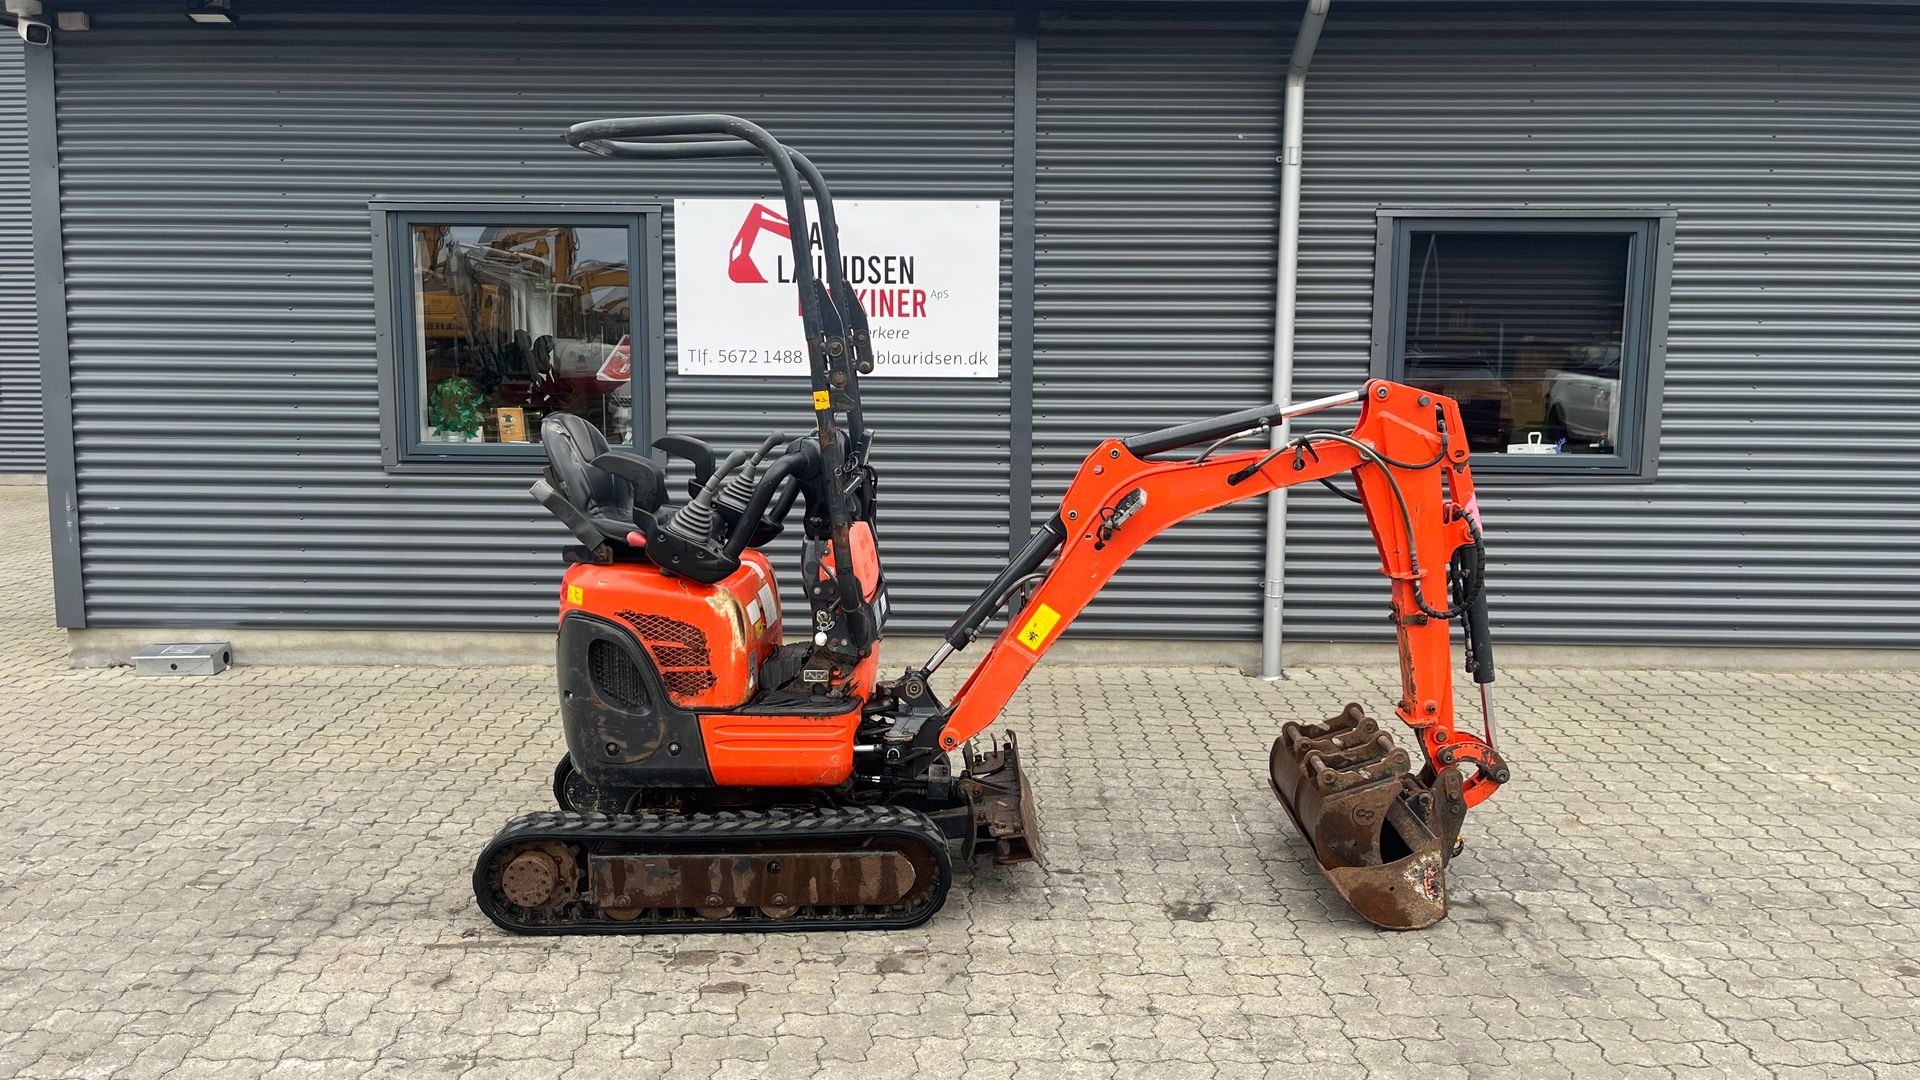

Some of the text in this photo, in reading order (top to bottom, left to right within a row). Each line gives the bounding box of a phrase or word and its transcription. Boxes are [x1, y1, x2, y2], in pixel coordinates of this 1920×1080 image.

[777, 255, 914, 285] LIDSEN
[798, 289, 950, 317] KINER ApS
[868, 326, 910, 340] rkere
[687, 349, 989, 366] Tlf. 5672 1488 blauridsen.dk
